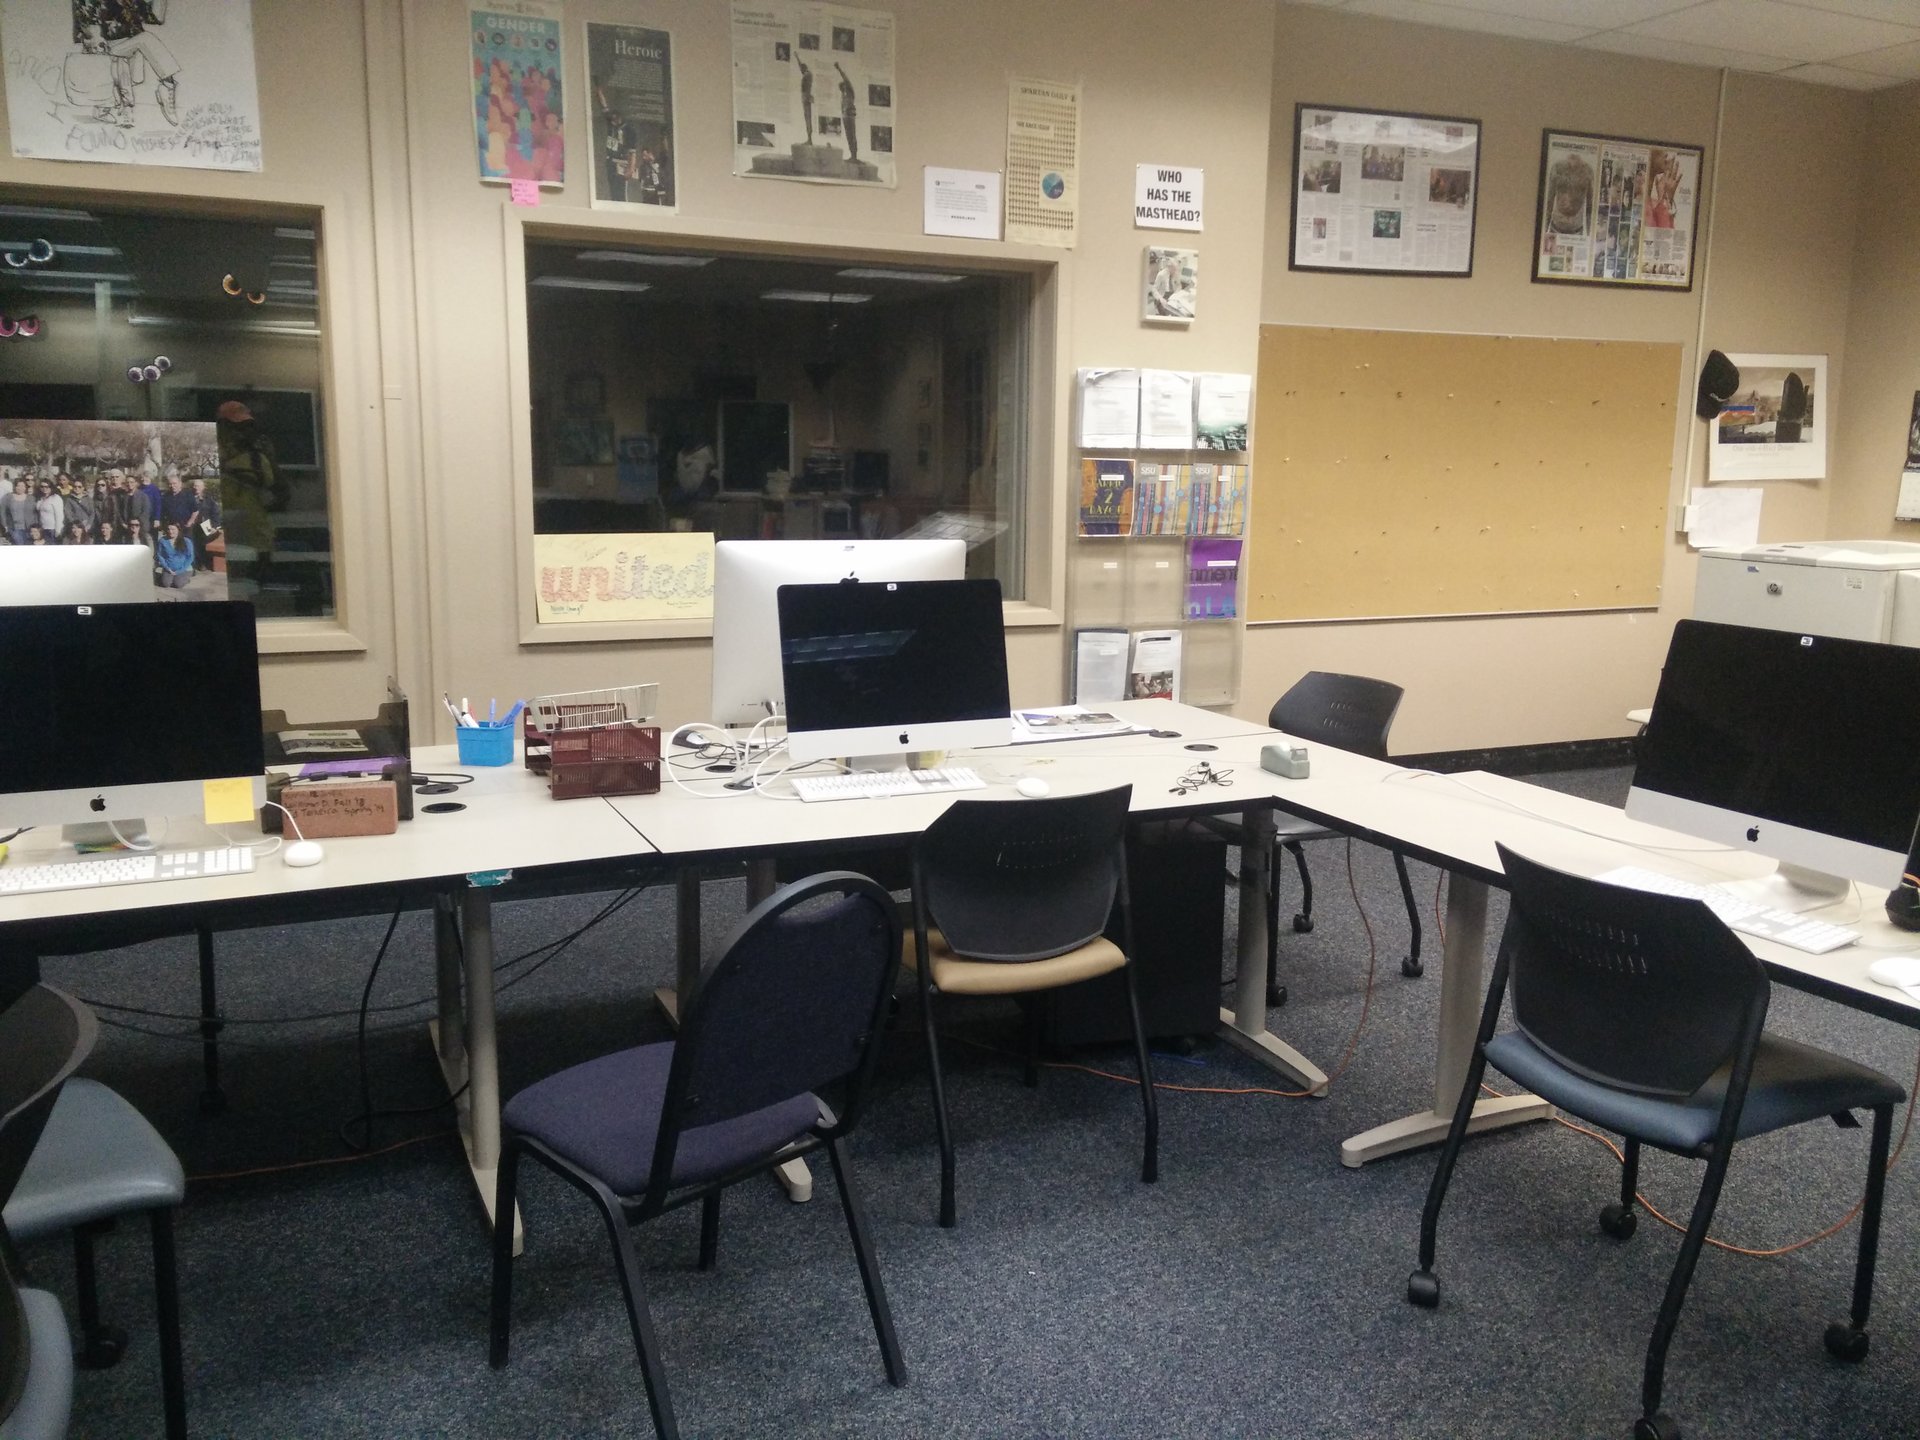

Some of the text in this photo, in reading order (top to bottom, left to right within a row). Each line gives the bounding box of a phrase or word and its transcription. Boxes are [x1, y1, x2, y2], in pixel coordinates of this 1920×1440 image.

[486, 16, 545, 34] GENDER
[615, 40, 662, 59] Heroic
[1157, 169, 1182, 183] WHO
[1146, 188, 1191, 203] HAS THE
[1136, 206, 1200, 222] MASTHEAD?
[1141, 466, 1156, 475] SISU
[1195, 466, 1211, 475] SISU
